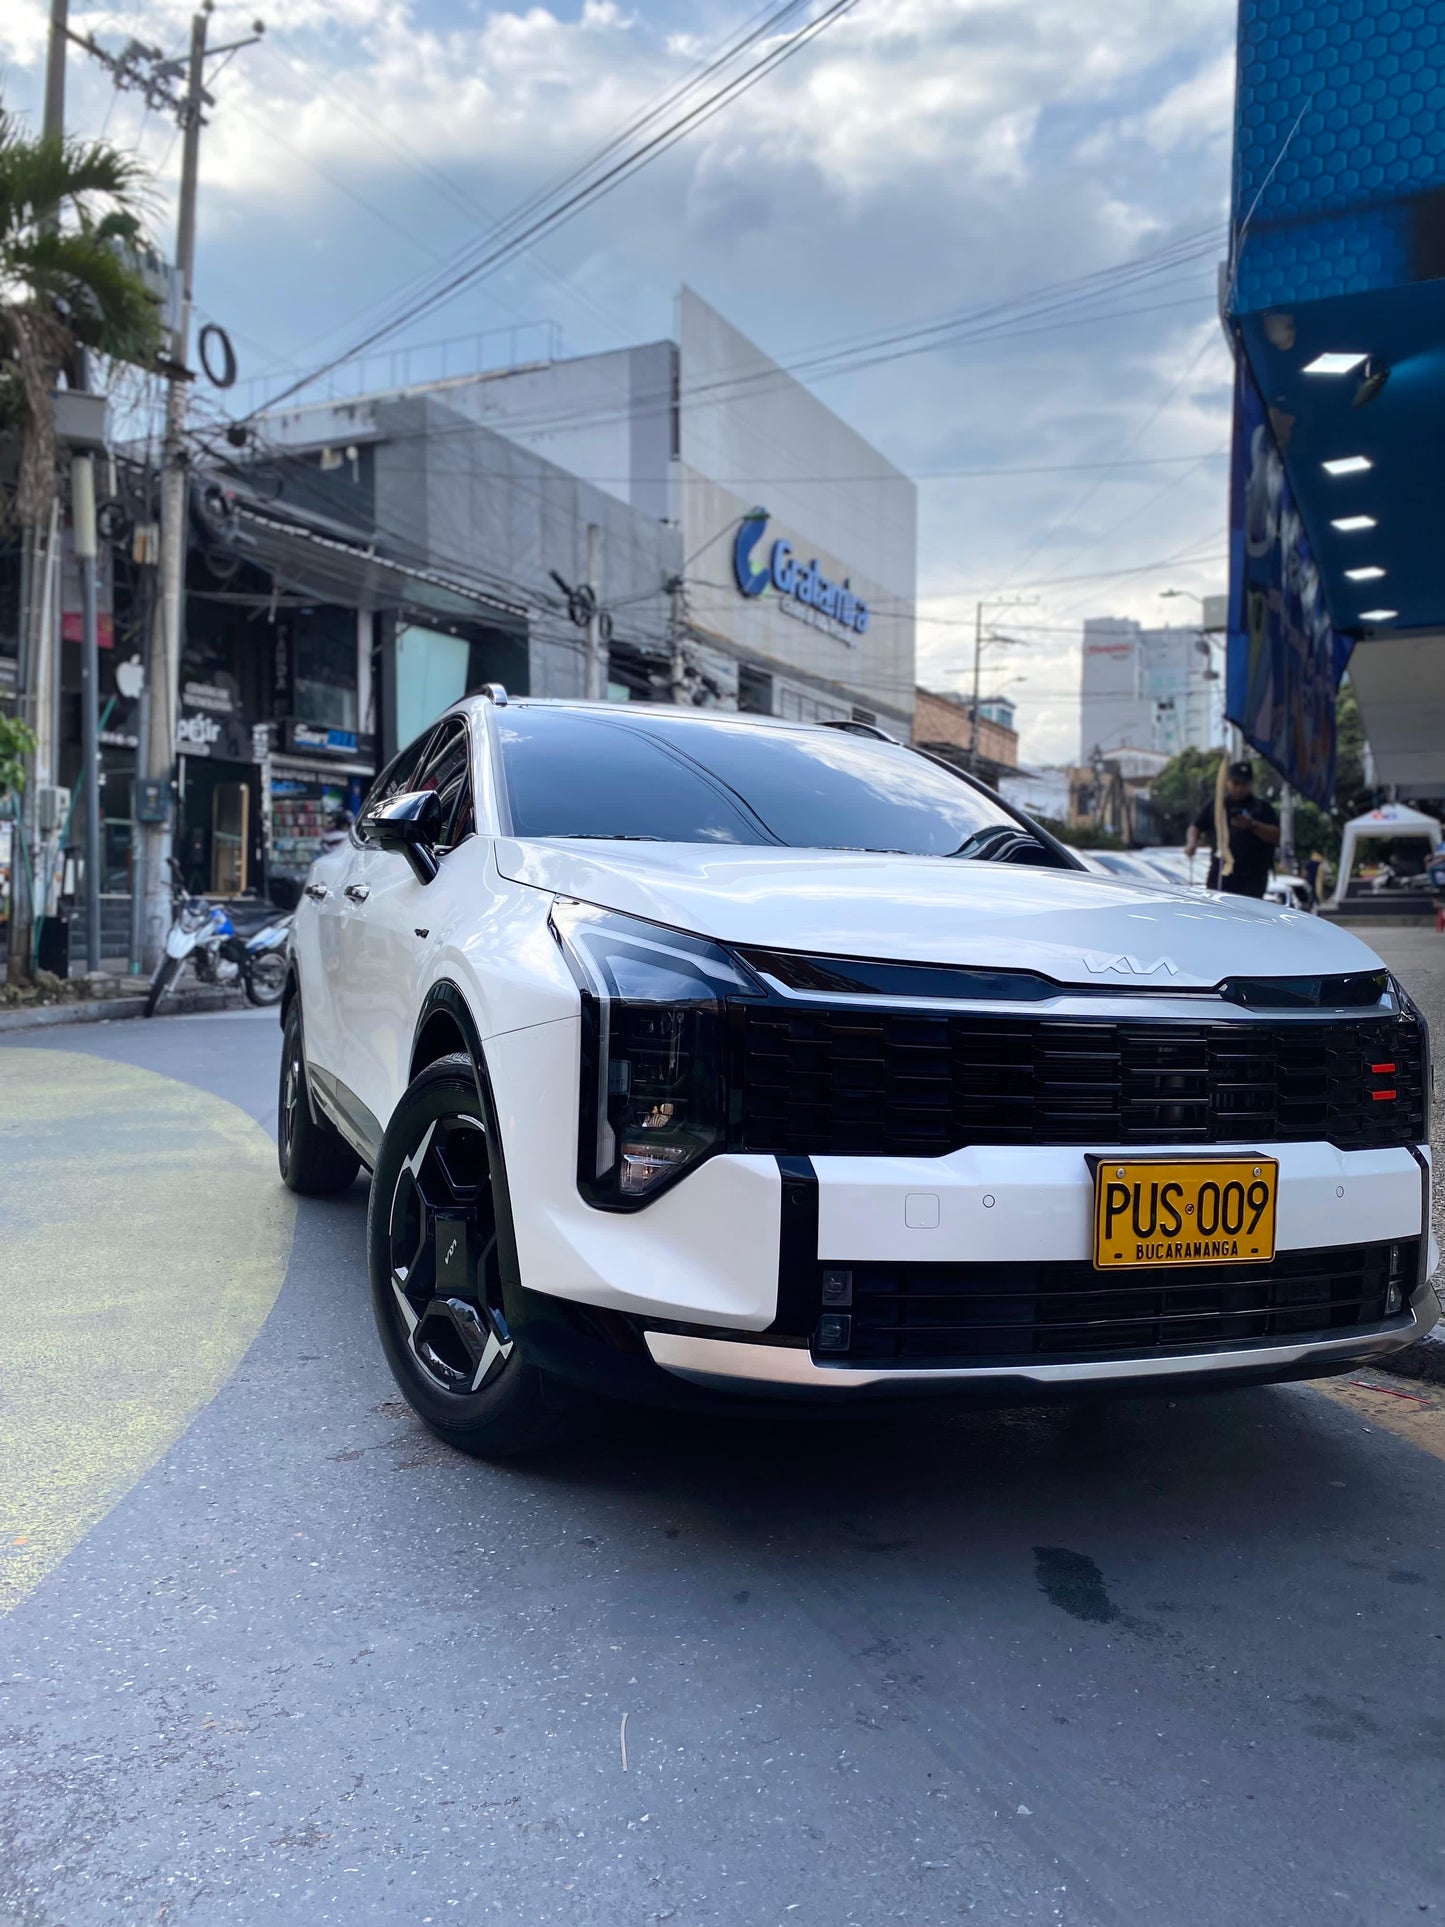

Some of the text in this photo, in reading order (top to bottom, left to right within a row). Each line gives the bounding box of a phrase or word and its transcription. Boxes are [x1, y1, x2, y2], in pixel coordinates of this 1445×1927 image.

[771, 539, 869, 635] Gratamira
[1105, 1181, 1269, 1239] PUS 009
[1136, 1240, 1238, 1260] BUCARAMANGA
